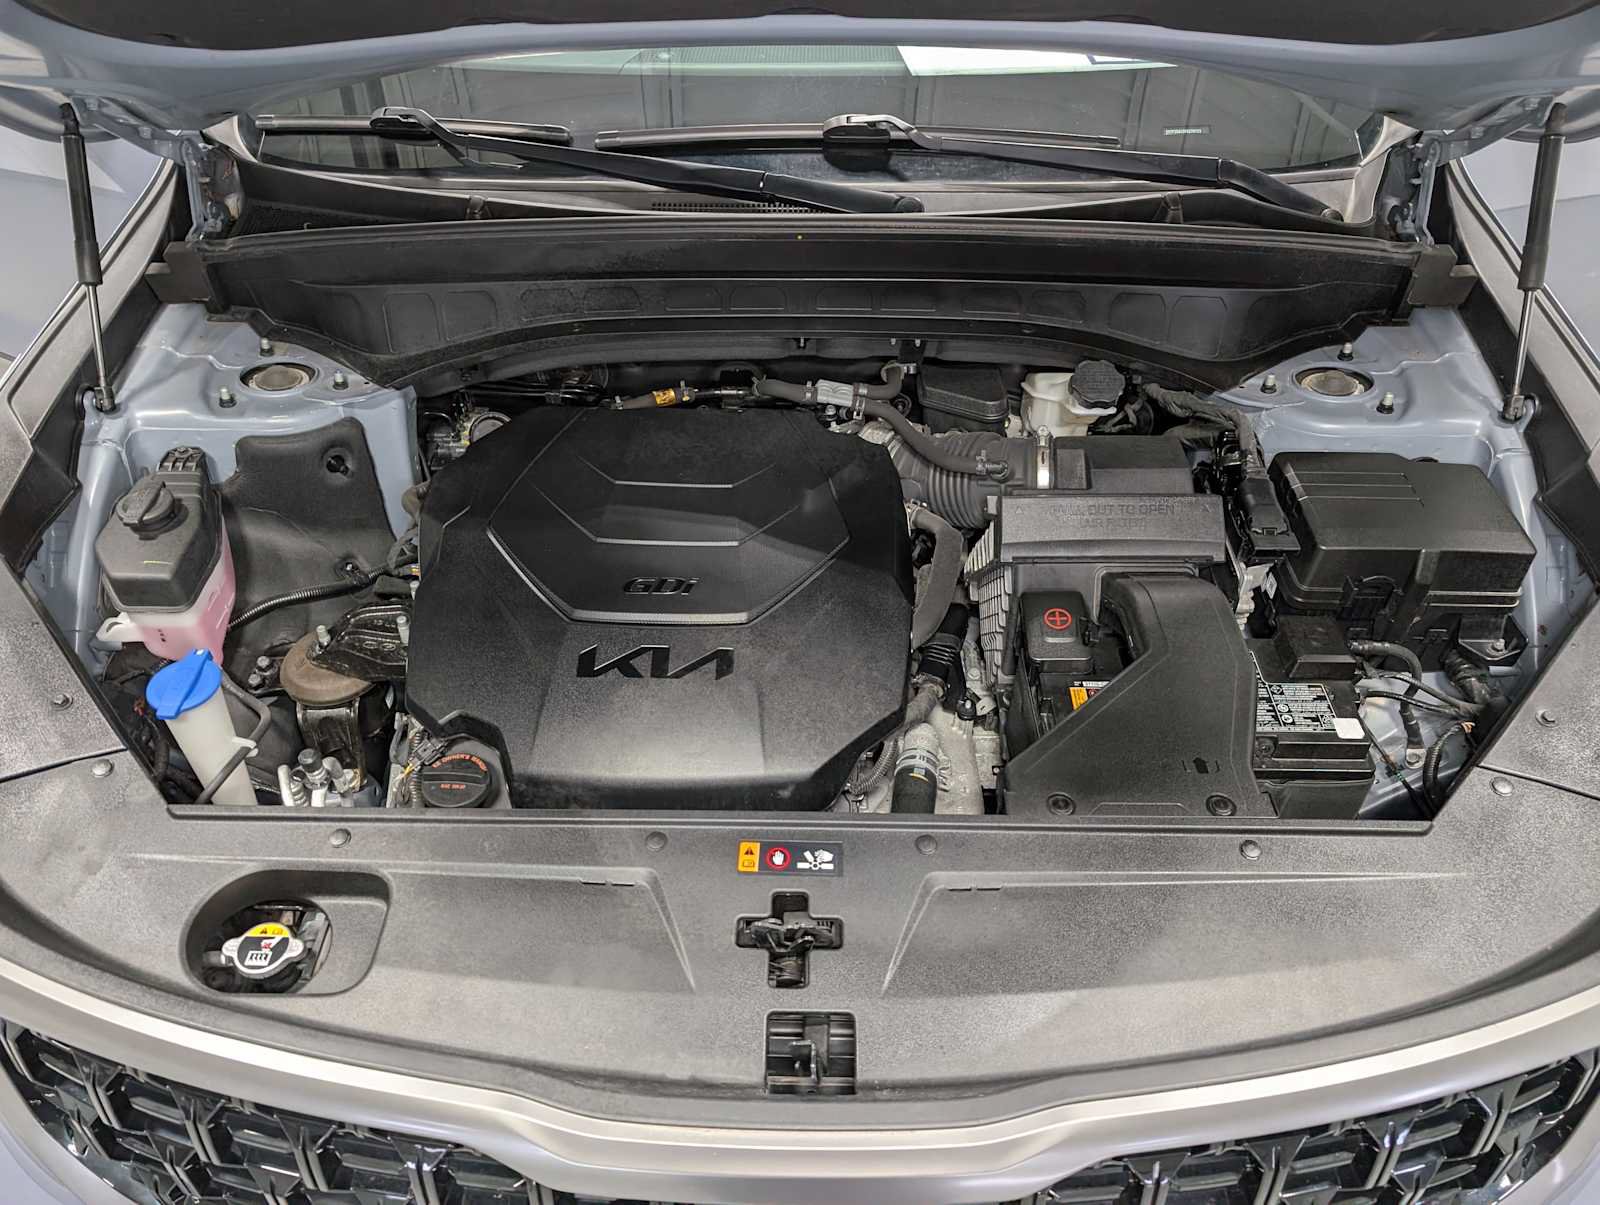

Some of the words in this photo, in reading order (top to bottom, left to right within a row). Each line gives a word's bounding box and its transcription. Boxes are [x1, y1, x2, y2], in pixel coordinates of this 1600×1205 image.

[1088, 503, 1115, 516] OUT
[1118, 503, 1137, 516] TO
[1139, 503, 1176, 516] OPEN
[623, 577, 699, 596] GDi
[576, 643, 735, 680] KIA
